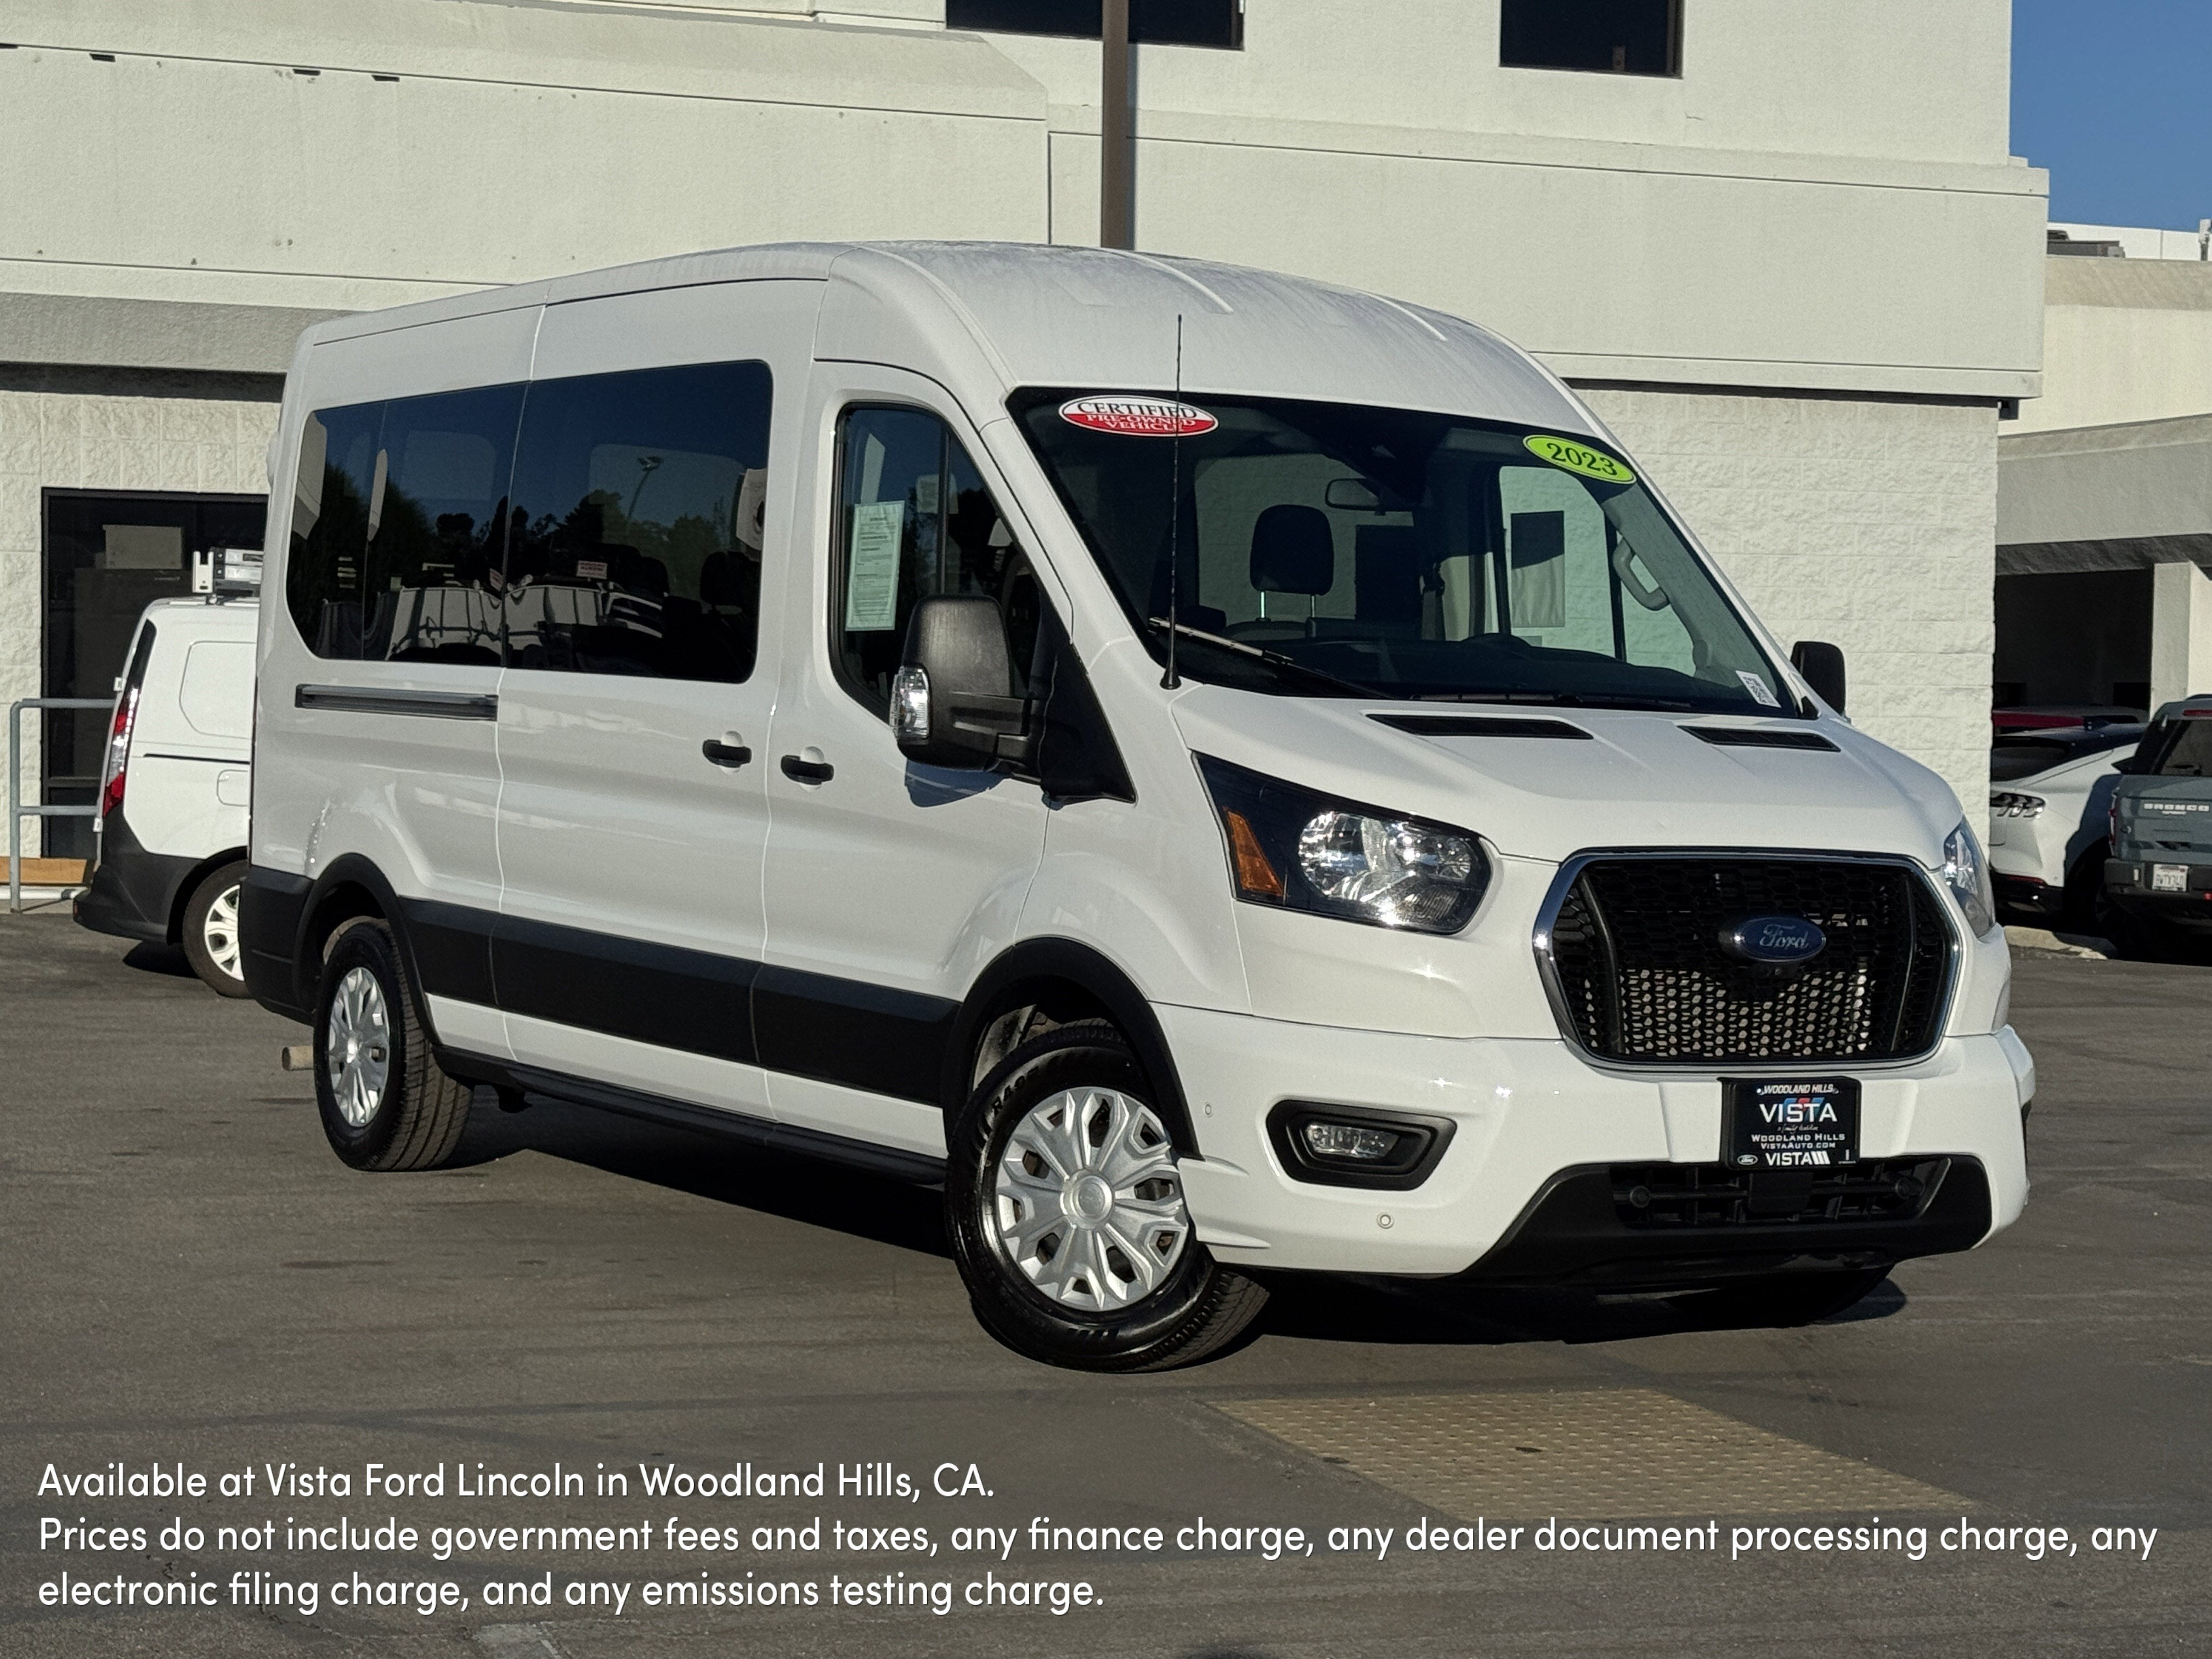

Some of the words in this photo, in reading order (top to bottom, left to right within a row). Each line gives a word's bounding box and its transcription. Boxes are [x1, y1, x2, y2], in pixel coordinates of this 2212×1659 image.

[1077, 402, 1197, 419] CERTIFIED
[1086, 414, 1197, 426] PRE-OWNED
[1546, 442, 1617, 476] 2023
[1759, 924, 1809, 950] Ford
[1763, 1084, 1810, 1094] WOODLAND
[1812, 1084, 1834, 1094] HILLS
[1759, 1103, 1838, 1123] VISTA
[1751, 1133, 1811, 1142] WOODLAND
[1815, 1133, 1846, 1141] HILLS
[1765, 1152, 1813, 1166] VISTA
